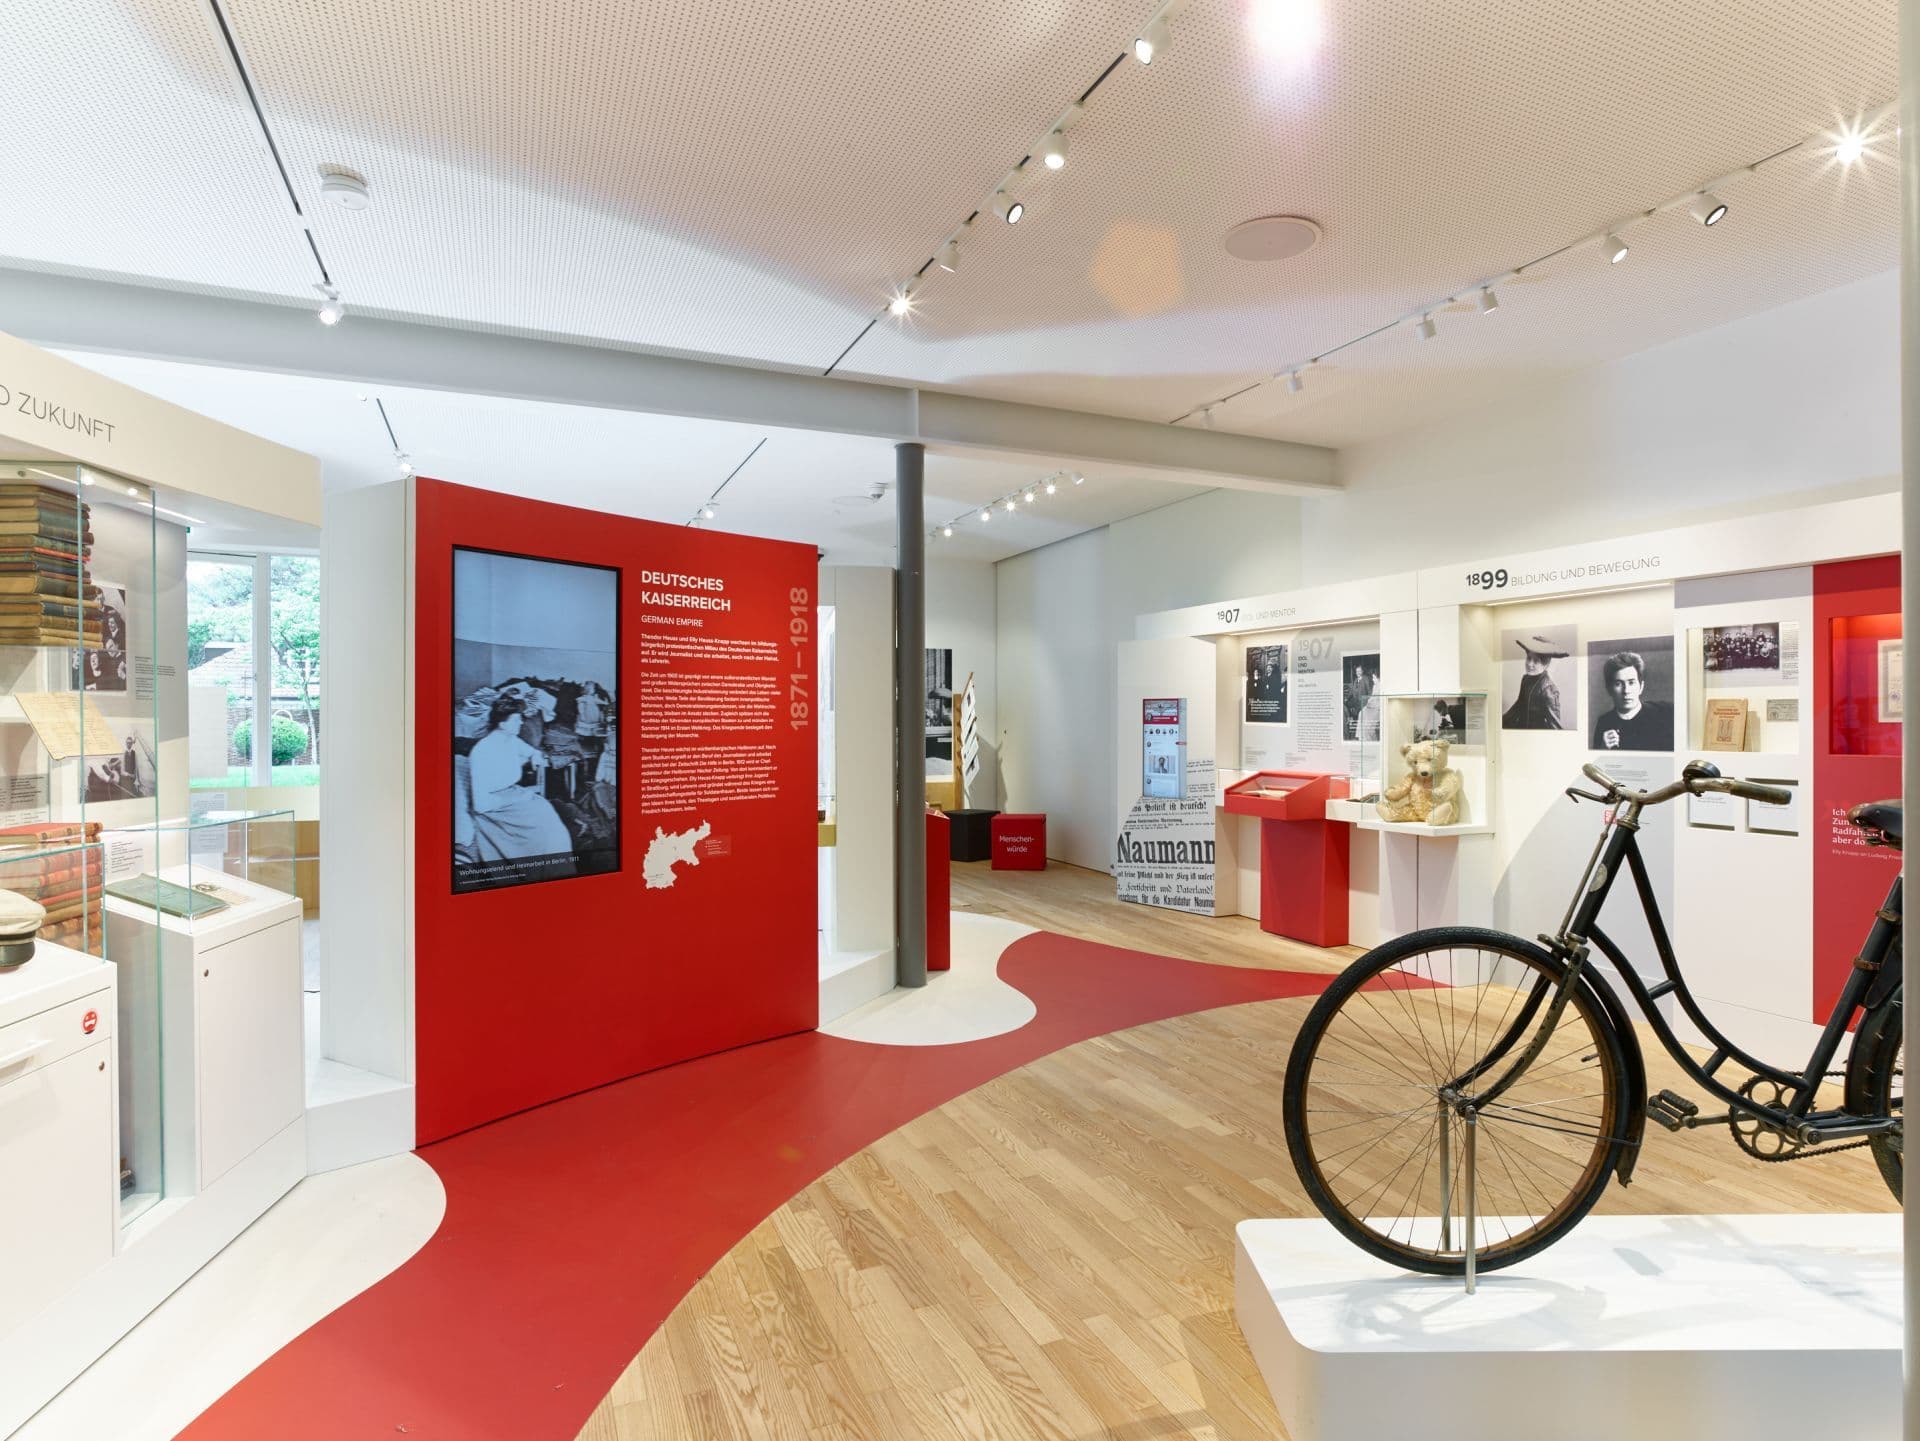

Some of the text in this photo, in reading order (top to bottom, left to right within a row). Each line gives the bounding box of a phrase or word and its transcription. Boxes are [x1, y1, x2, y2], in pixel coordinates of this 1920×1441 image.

[18, 391, 116, 443] ZUKUNFT
[641, 571, 724, 591] DEUTSCHES
[1465, 556, 1661, 590] 1899 BILDUNG UND BEWEGUNG
[641, 591, 731, 611] KAISERREICH
[641, 615, 704, 627] GERMAN EMPIRE
[790, 587, 808, 647] 1918
[1217, 608, 1240, 623] 1907
[790, 673, 808, 731] 1871
[1832, 808, 1846, 816] Ich
[1832, 818, 1850, 826] Zun
[1117, 831, 1215, 864] Naumann
[1832, 836, 1866, 846] aber do
